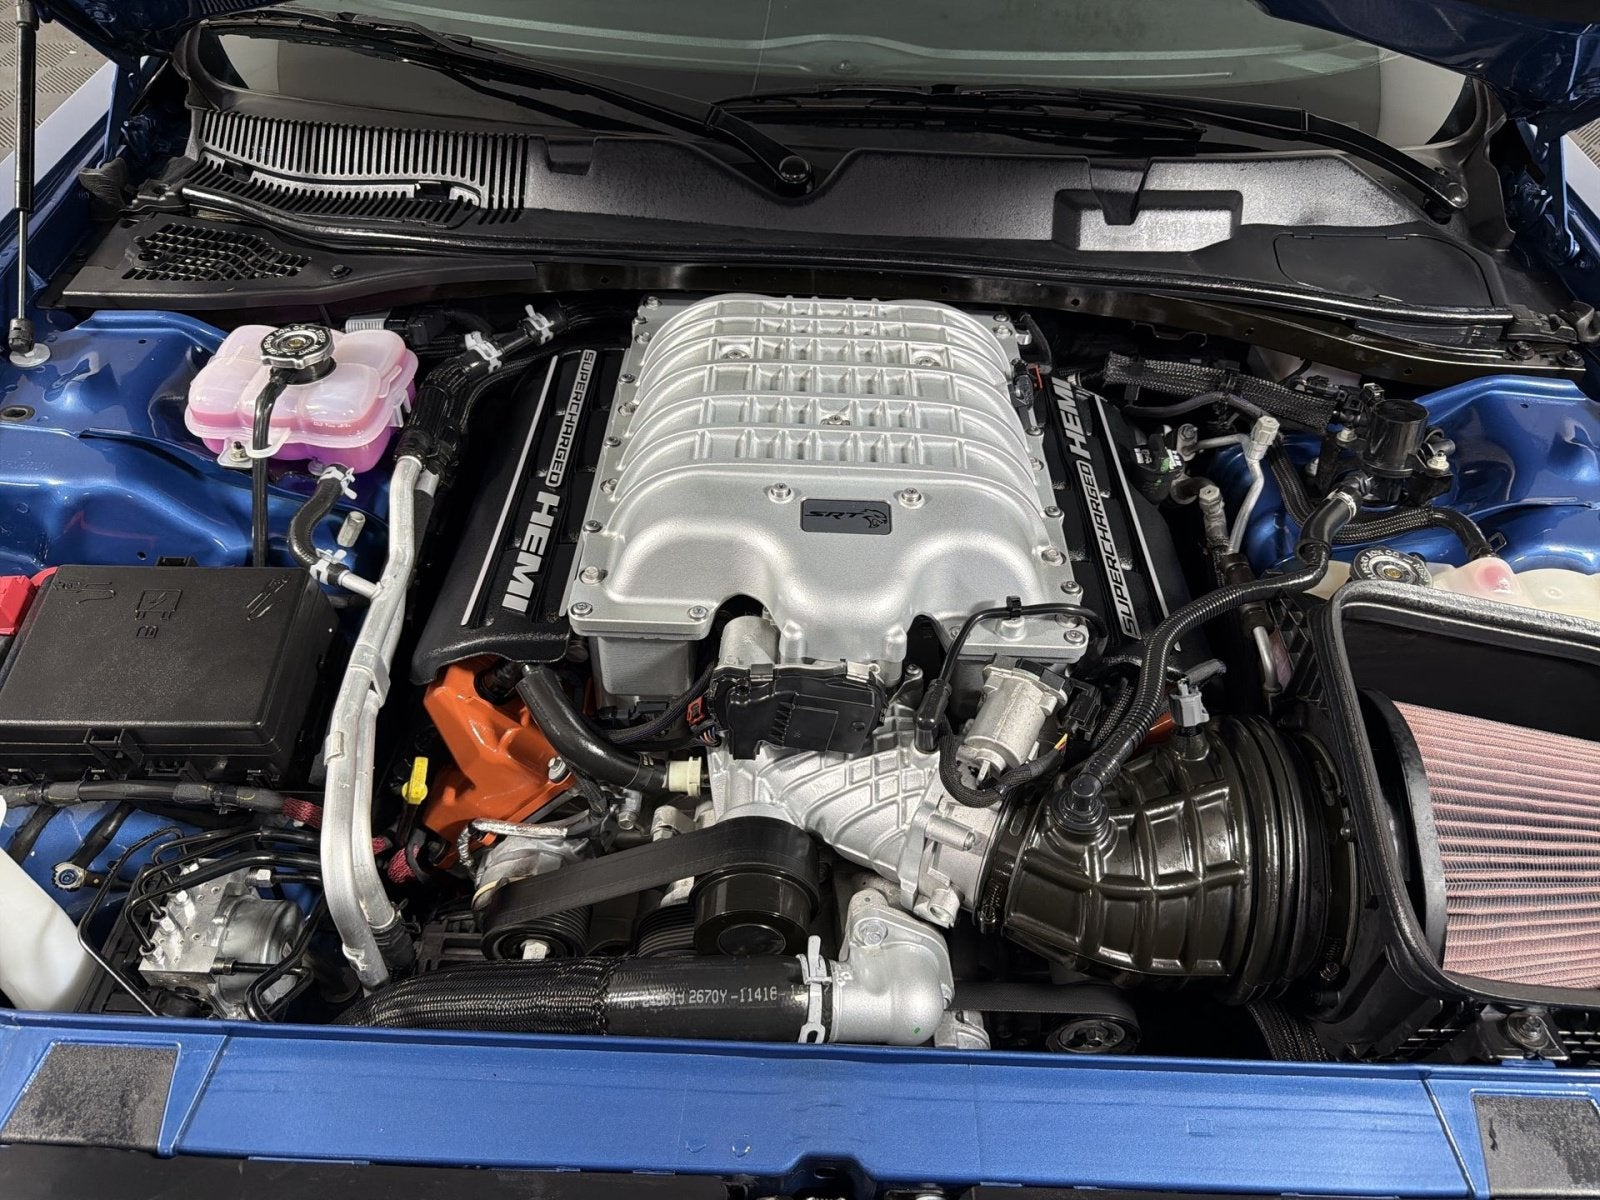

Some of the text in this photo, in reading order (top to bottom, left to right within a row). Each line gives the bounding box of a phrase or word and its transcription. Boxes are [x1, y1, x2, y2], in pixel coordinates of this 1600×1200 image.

[501, 350, 595, 612] SUPERCHARGED HEMI
[805, 511, 863, 519] SRT
[1051, 376, 1140, 638] SUPERCHARGED HEMI
